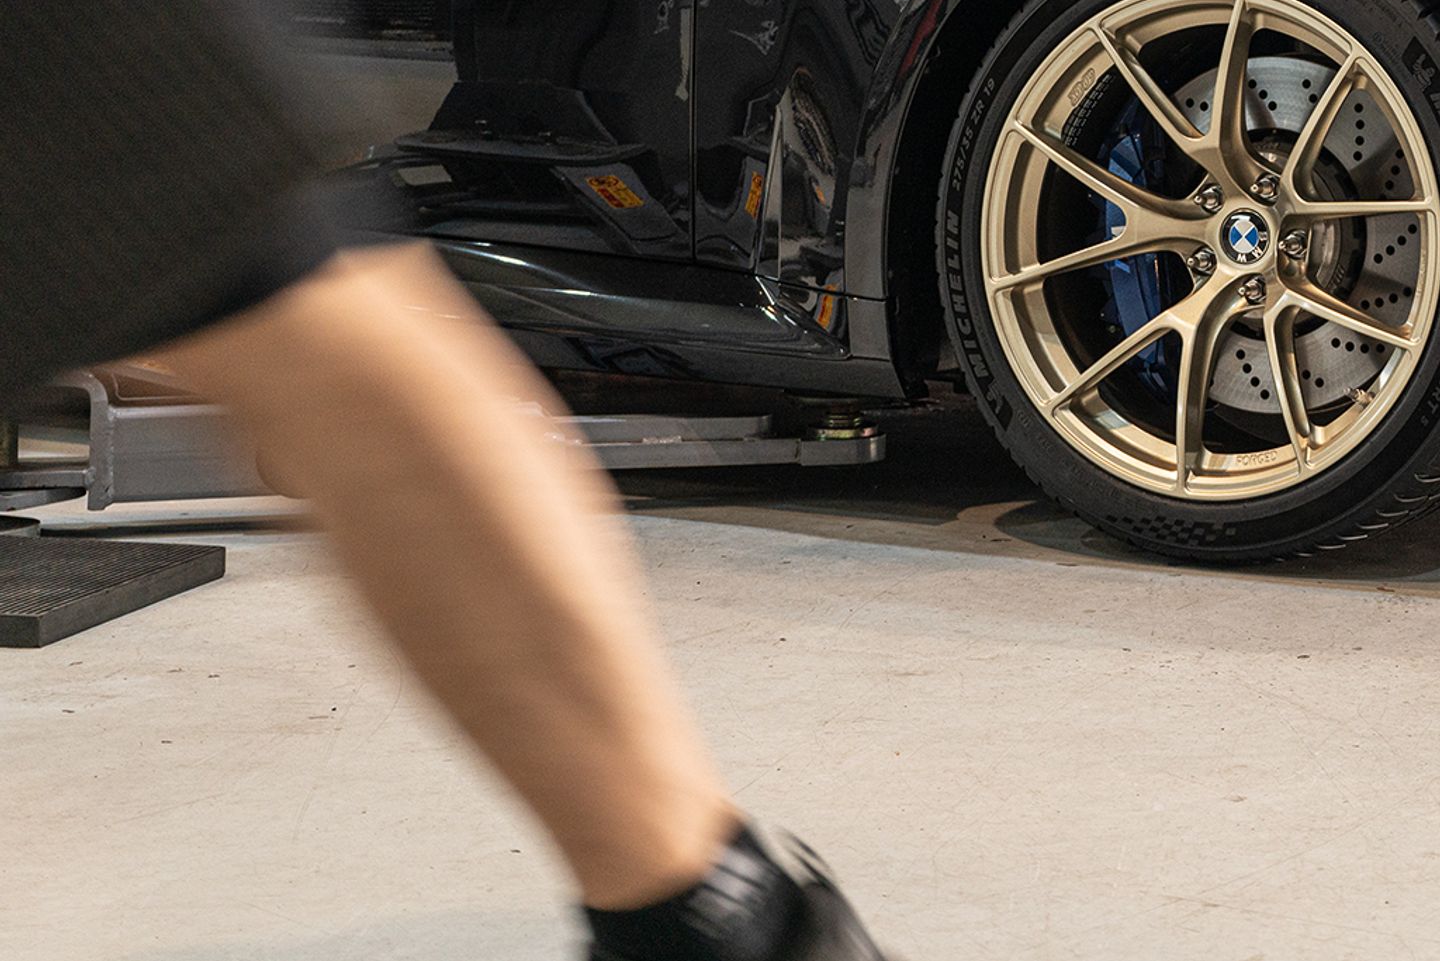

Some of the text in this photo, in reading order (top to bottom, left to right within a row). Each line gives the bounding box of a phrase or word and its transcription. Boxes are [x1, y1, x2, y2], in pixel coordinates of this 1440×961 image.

[946, 77, 996, 384] MICHELIN 275/35 ZR 19
